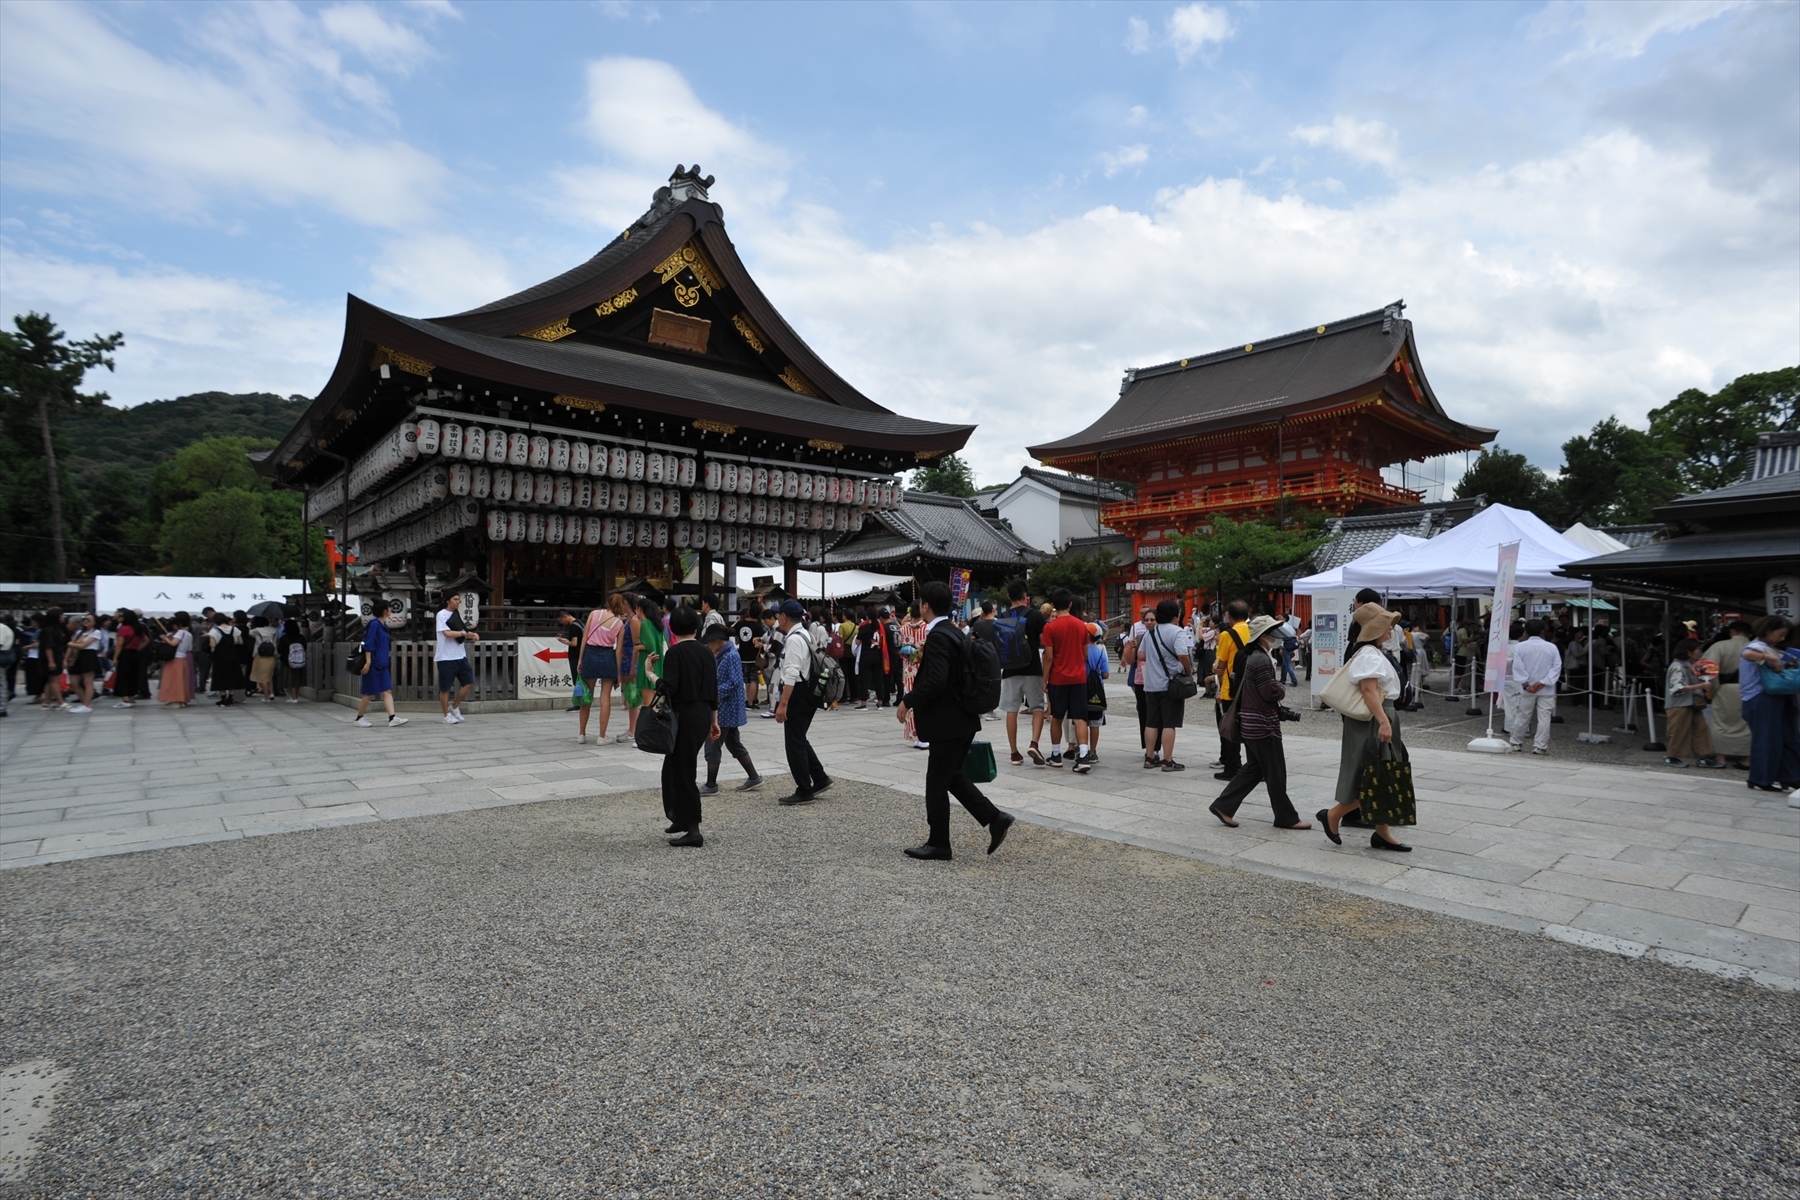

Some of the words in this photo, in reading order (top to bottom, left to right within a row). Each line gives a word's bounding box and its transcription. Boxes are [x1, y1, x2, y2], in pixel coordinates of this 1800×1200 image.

[449, 425, 458, 455] 家田荘子
[516, 435, 525, 460] たまや
[558, 441, 567, 467] 富美代
[577, 444, 586, 470] いし初
[155, 592, 267, 600] 八坂神社
